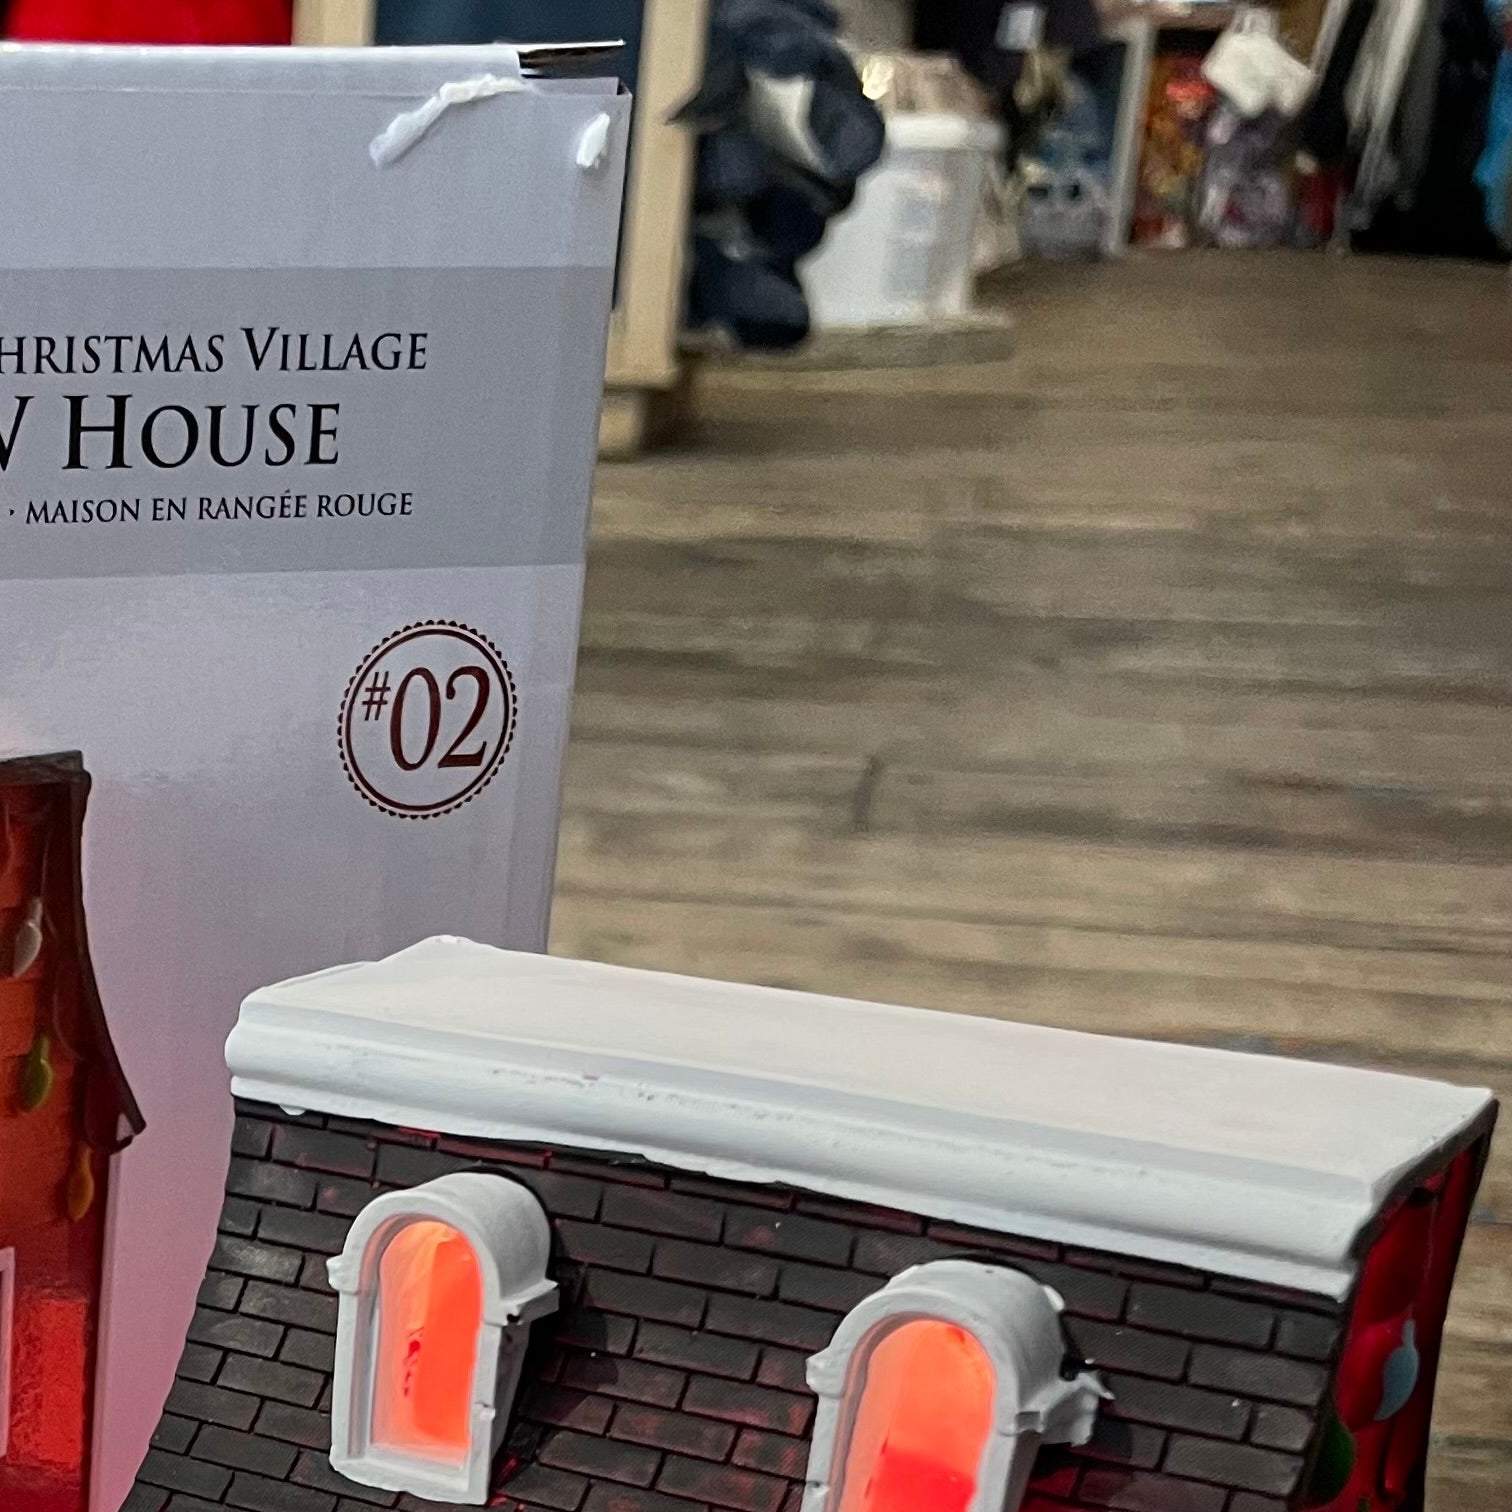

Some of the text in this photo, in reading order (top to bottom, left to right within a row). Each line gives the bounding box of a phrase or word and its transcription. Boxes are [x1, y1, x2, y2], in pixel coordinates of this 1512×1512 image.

[240, 326, 428, 373] VILLAGE
[61, 393, 340, 471] HOUSE
[25, 498, 140, 524] MAISON
[151, 497, 187, 521] EN
[197, 489, 308, 520] RANGÉE
[316, 492, 414, 518] ROUGE
[361, 665, 490, 771] #02
